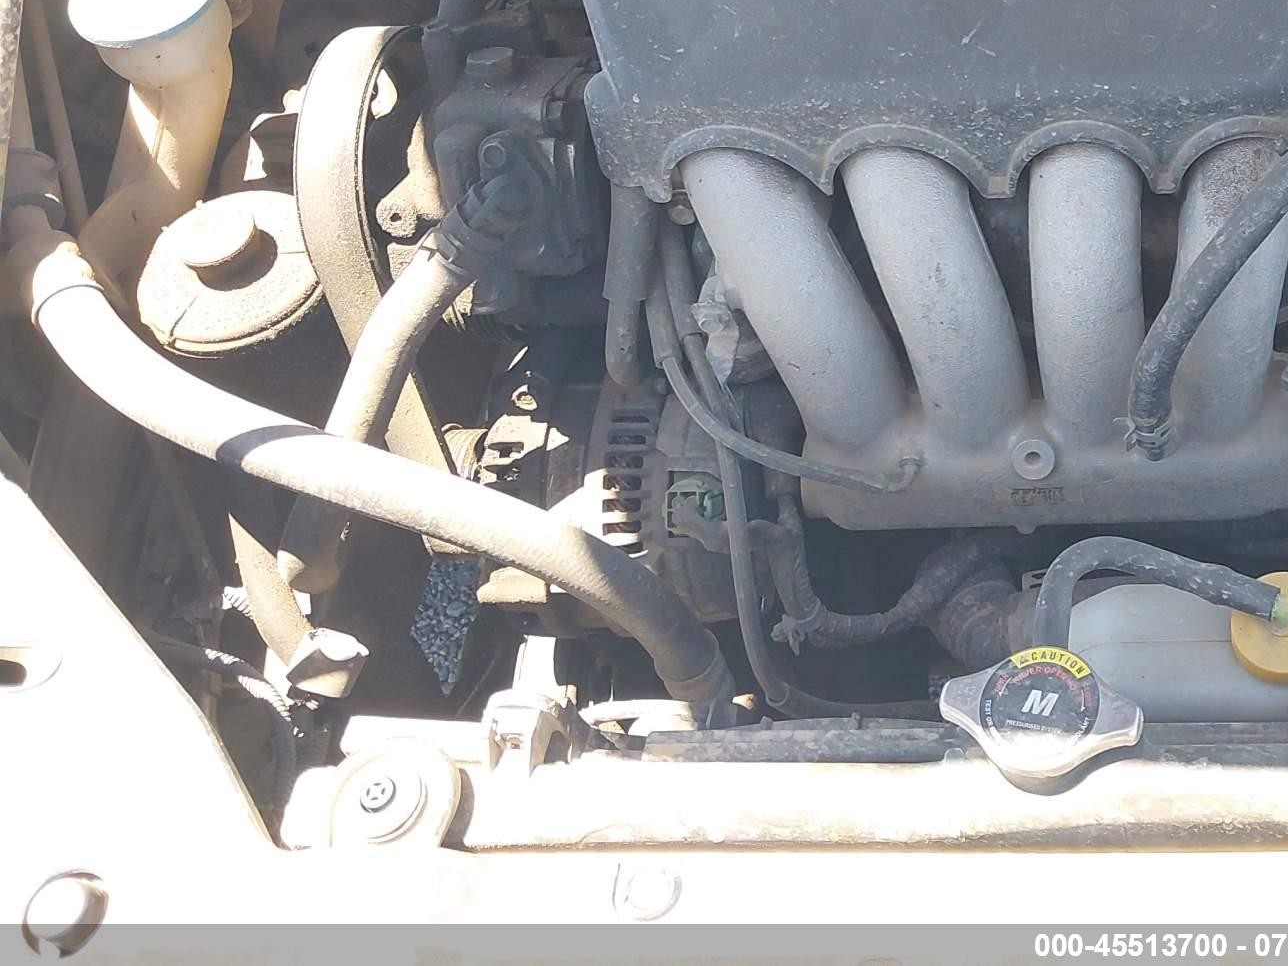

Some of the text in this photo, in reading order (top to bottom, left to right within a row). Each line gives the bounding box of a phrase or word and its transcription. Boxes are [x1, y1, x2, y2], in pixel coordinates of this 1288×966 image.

[1031, 650, 1085, 675] CAUTION
[984, 699, 992, 715] TEST
[1021, 689, 1060, 717] M
